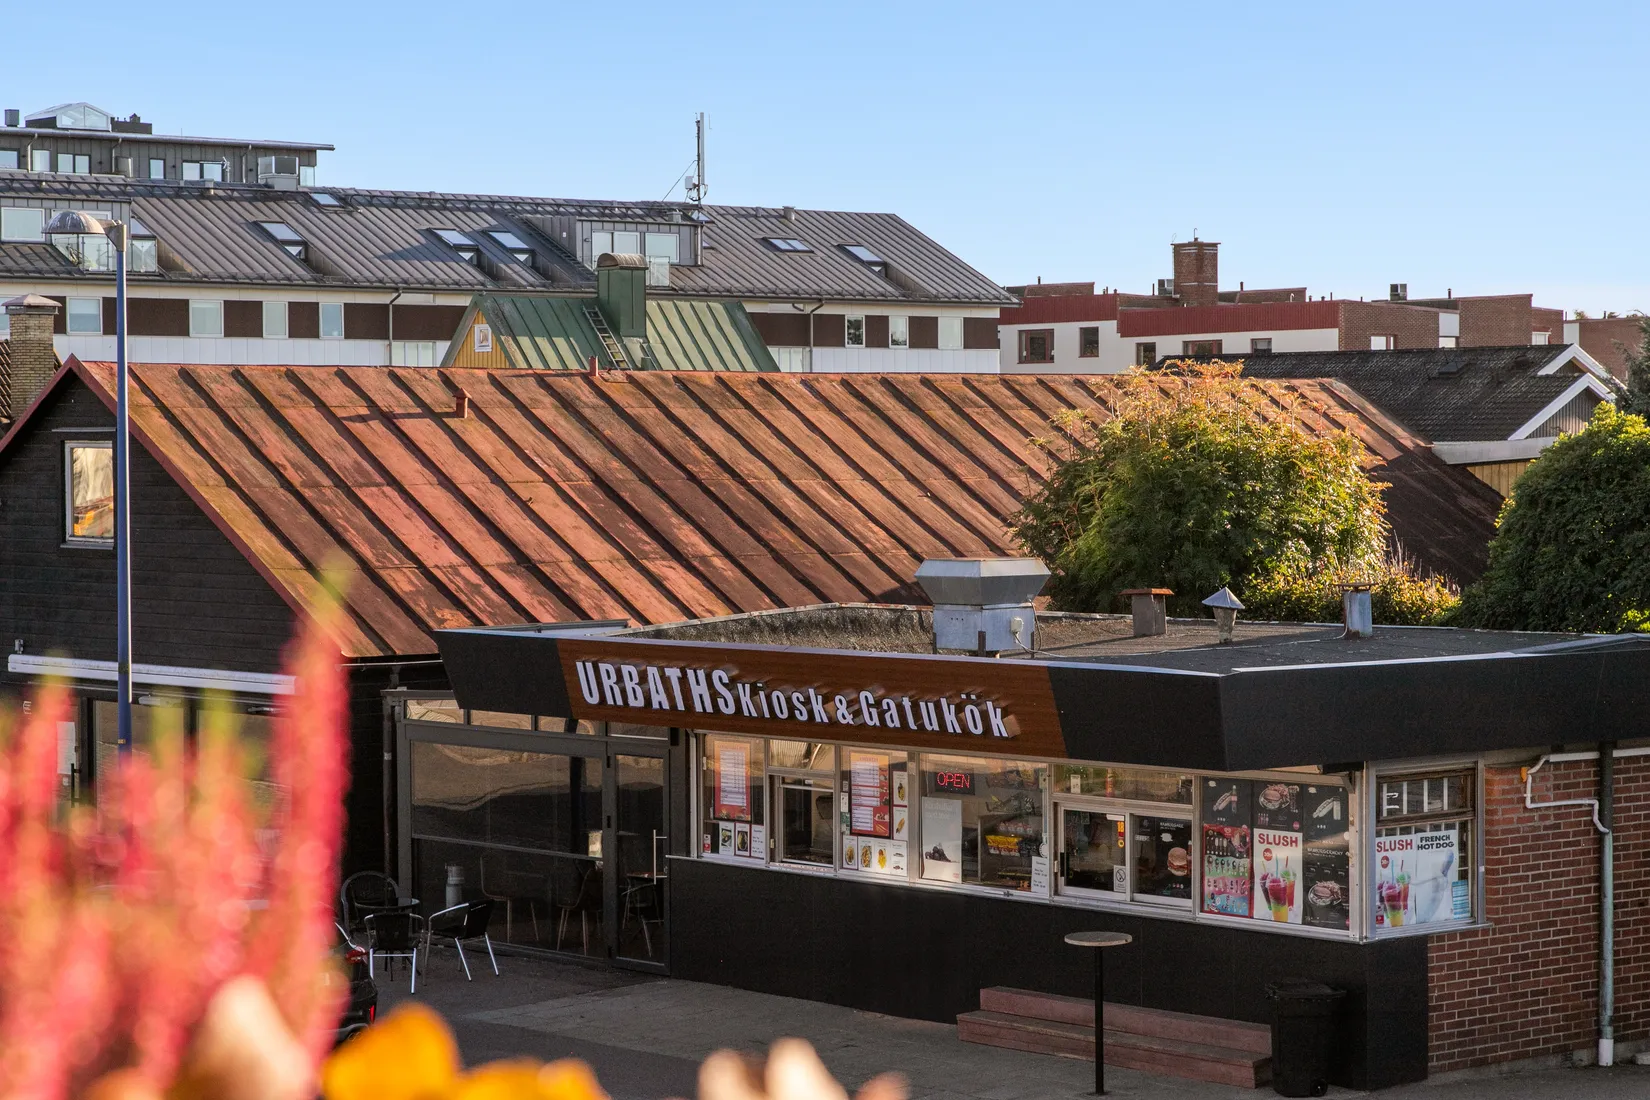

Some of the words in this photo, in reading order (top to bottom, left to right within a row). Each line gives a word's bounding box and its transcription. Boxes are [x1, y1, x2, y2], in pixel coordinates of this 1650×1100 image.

[576, 661, 736, 715] URBATHS
[737, 683, 829, 723] Kiosk
[834, 695, 854, 724] &
[859, 690, 1009, 738] Gatukök
[936, 771, 971, 788] OPEN
[1258, 832, 1299, 847] SLUSH
[1419, 834, 1451, 843] FRENCH
[1376, 839, 1413, 853] SLUSH
[1417, 842, 1434, 851] HOT
[1435, 841, 1455, 849] DOG
